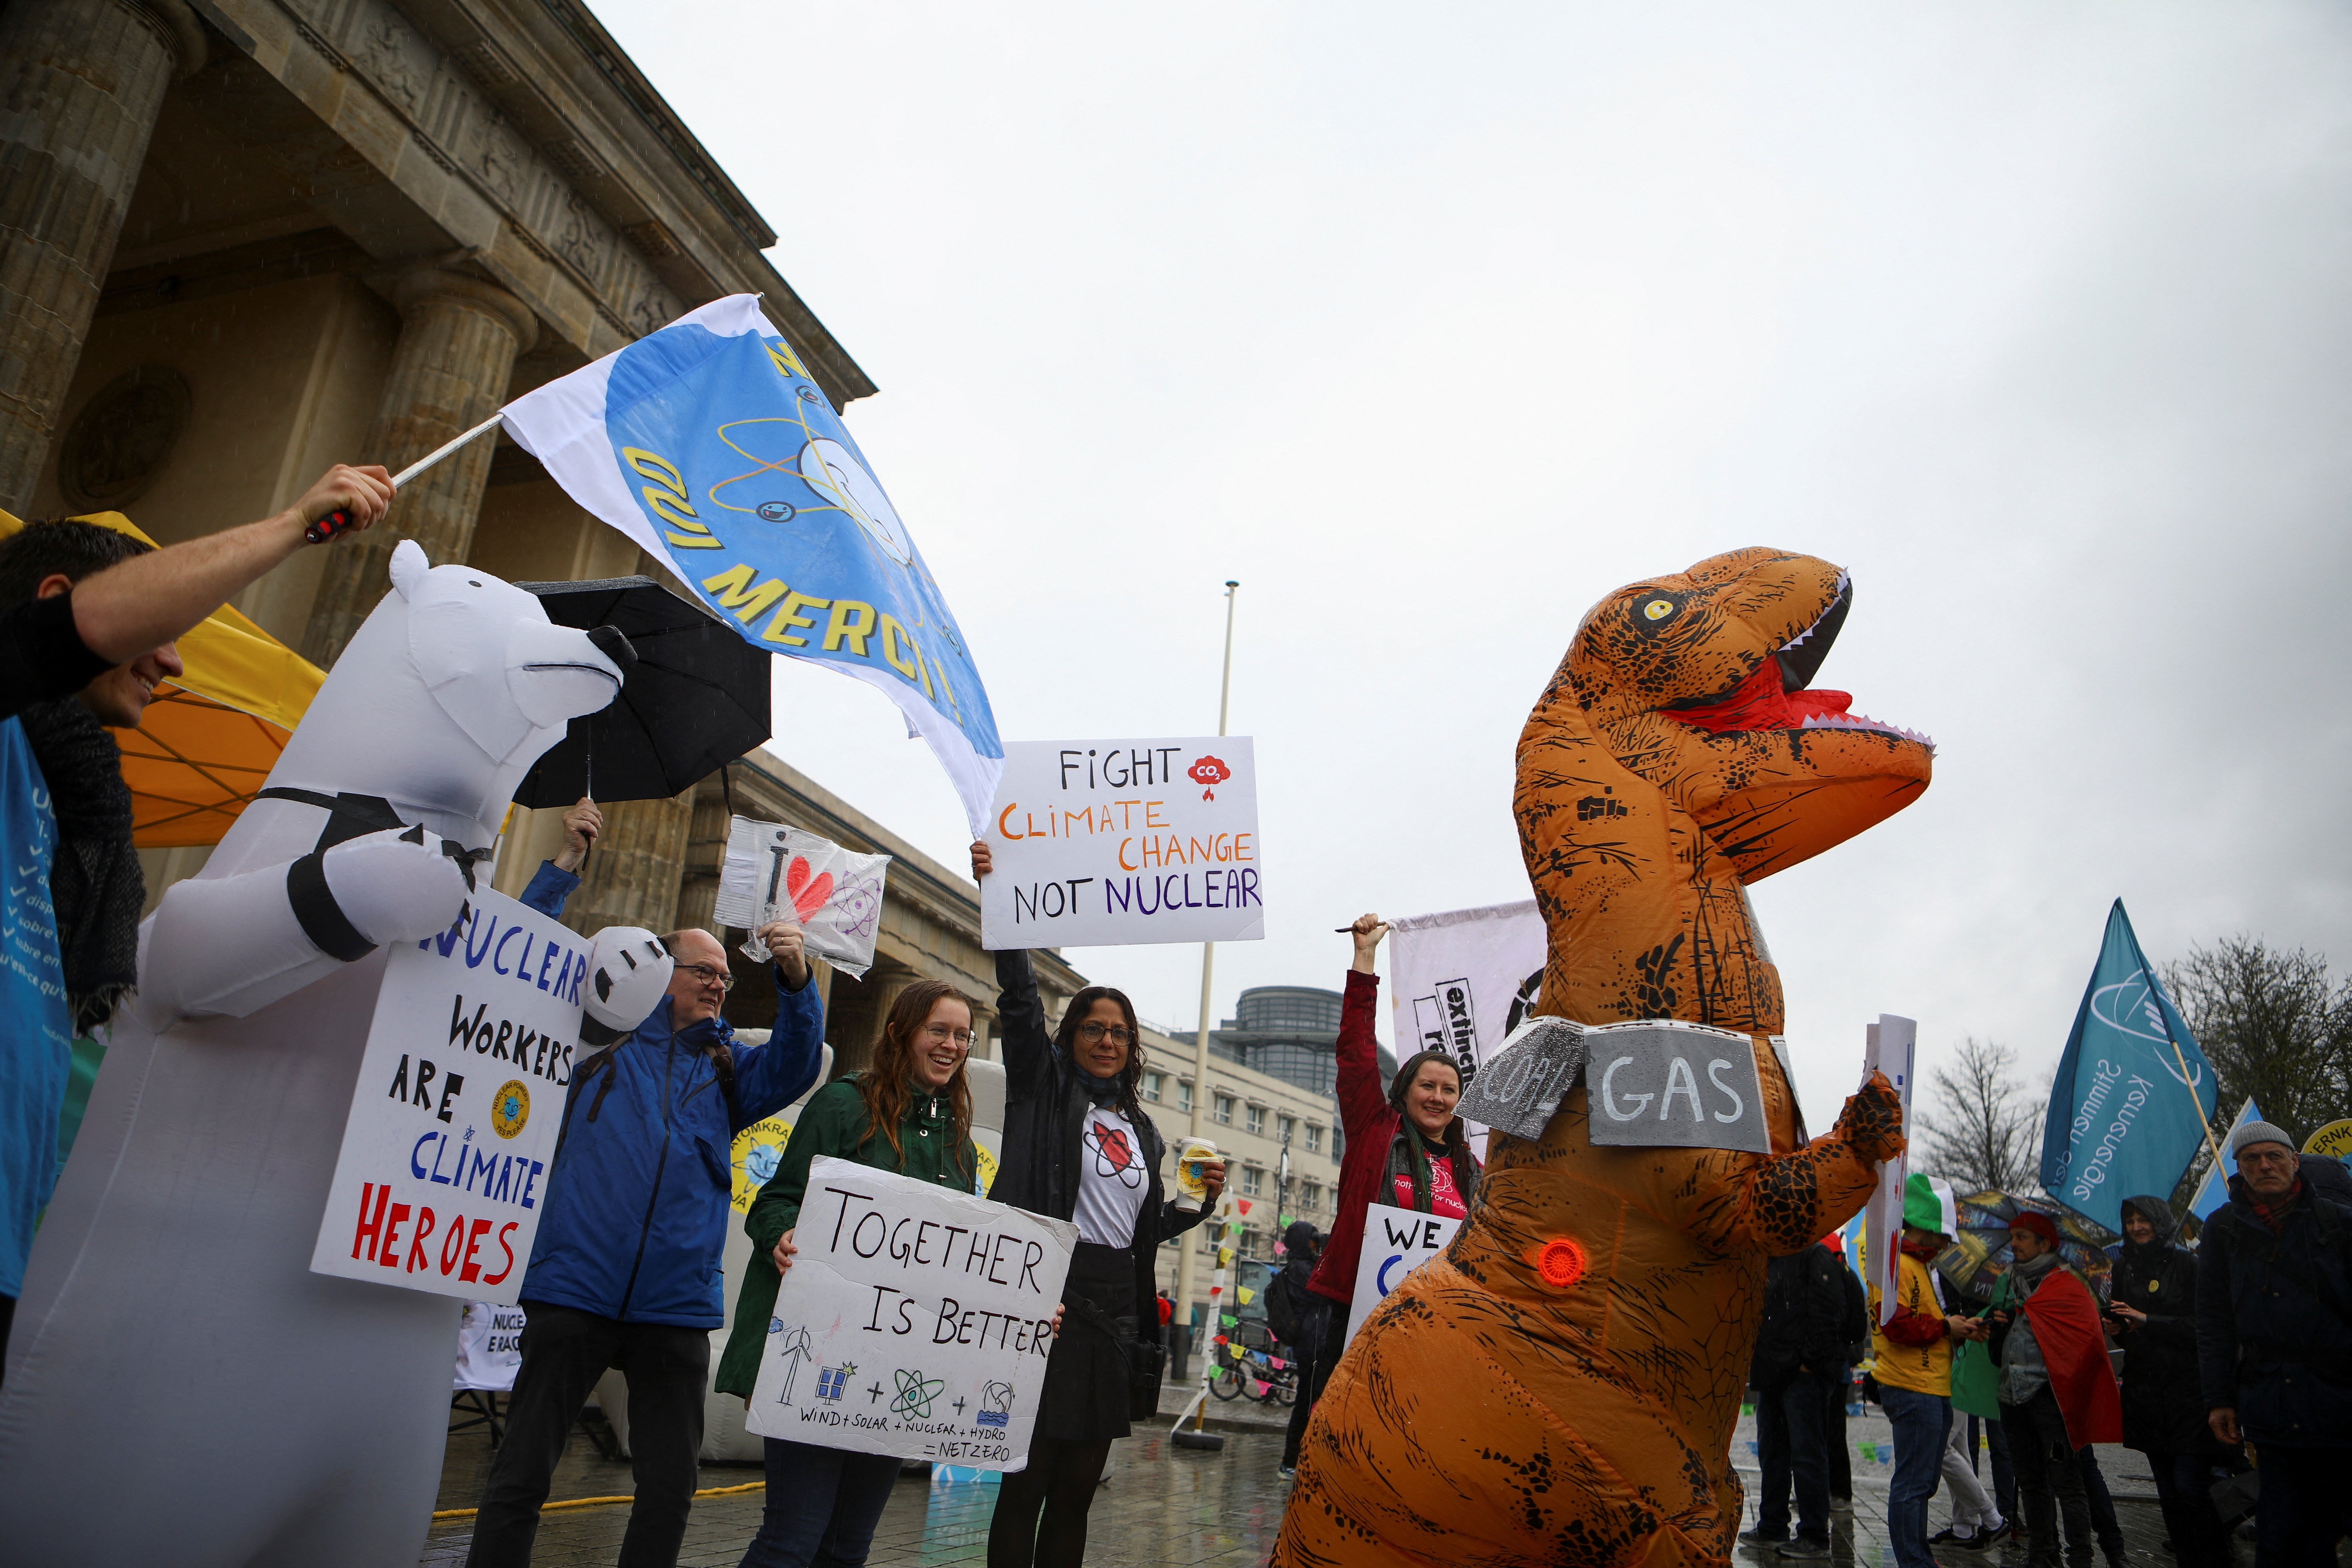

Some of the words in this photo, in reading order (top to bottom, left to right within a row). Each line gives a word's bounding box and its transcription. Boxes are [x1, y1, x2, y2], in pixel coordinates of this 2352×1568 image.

[1118, 832, 1253, 872] CHANGE
[26, 895, 55, 916] disp
[1014, 877, 1093, 924] NOT
[1105, 868, 1263, 915] NUCLEAR
[448, 994, 572, 1086] WORKERS
[1447, 987, 1477, 1093] extincti
[388, 1054, 465, 1123] ARE
[493, 1082, 513, 1110] NUCLEAR
[1601, 1055, 1744, 1123] GAS
[496, 1123, 506, 1136] YES
[506, 1117, 526, 1137] PLEASE
[730, 1122, 789, 1151] ATOMKRA
[2309, 1125, 2352, 1154] ERNK
[350, 1181, 519, 1286] HEROES
[824, 1186, 1042, 1294] TOGETHER
[1384, 1217, 1441, 1251] WE
[863, 1285, 915, 1335] IS
[932, 1297, 1052, 1358] BETTER
[851, 1415, 889, 1432] SOLAR
[905, 1421, 956, 1435] NUCLEAR
[970, 1427, 1006, 1441] HYDRO
